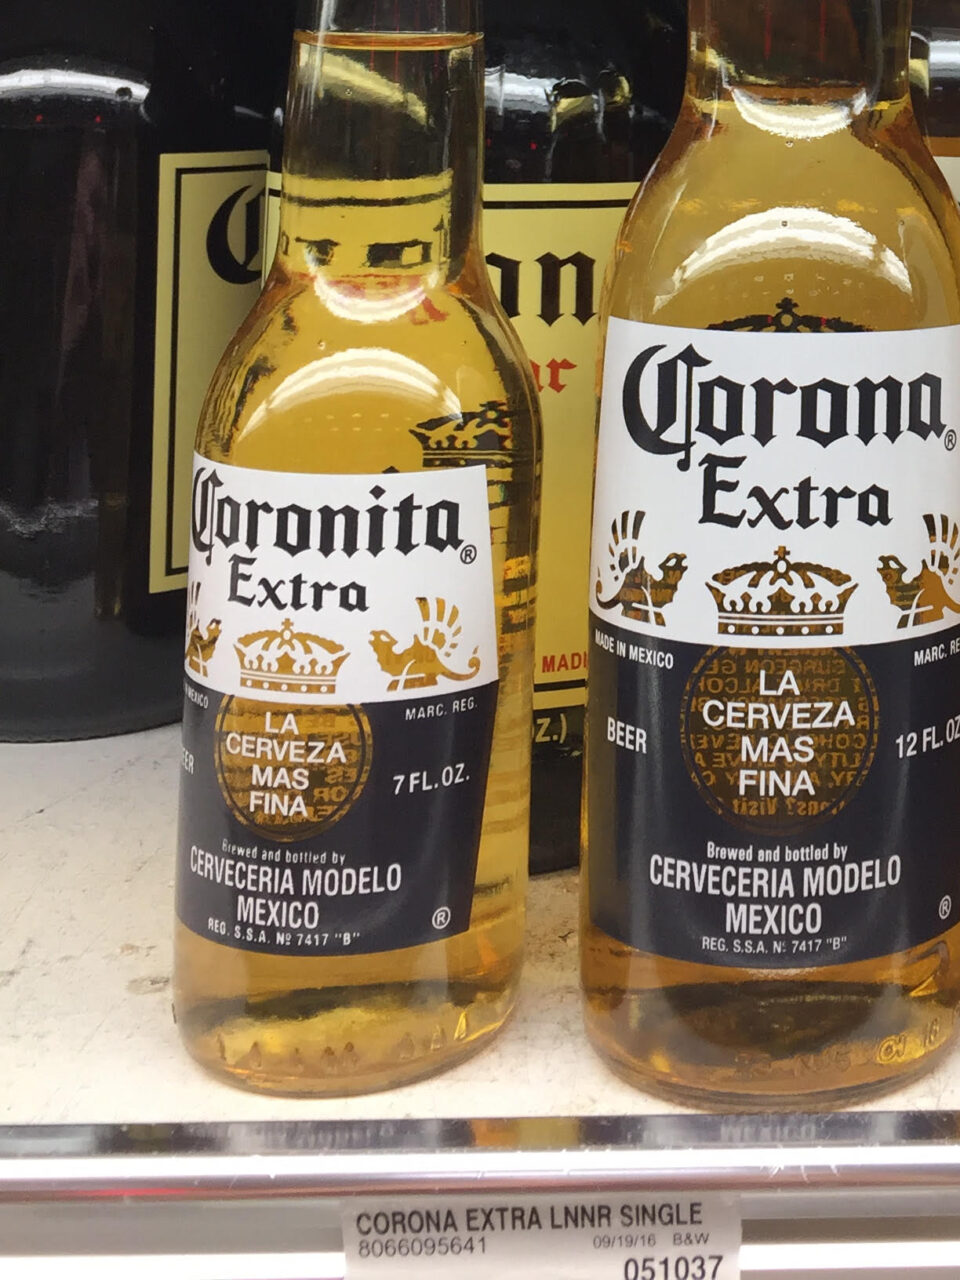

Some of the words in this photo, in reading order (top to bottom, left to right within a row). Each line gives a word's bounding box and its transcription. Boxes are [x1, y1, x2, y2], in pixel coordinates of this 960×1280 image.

[621, 342, 947, 472] Corona
[697, 453, 894, 530] Extra
[193, 466, 464, 566] Coronita
[227, 553, 369, 613] Extra
[595, 628, 614, 654] MADE
[616, 639, 627, 659] IN
[629, 643, 674, 670] MEXICO
[913, 643, 948, 667] MARC.
[759, 669, 800, 696] LA
[405, 703, 447, 721] MARC.
[452, 696, 478, 713] REG.
[702, 699, 856, 730] CERVEZA
[265, 711, 299, 735] LA
[607, 716, 647, 754] BEER
[225, 733, 347, 764] CERVEZA
[741, 735, 815, 763] MAS
[251, 764, 310, 790] MAS
[738, 769, 816, 797] FINA
[249, 792, 308, 817] FINA
[222, 838, 258, 859] Brewed
[261, 849, 280, 862] and
[331, 851, 346, 866] by
[707, 841, 753, 861] Brewed
[757, 845, 780, 862] and
[785, 844, 829, 862] bottled
[833, 842, 848, 861] by
[190, 845, 295, 896] CERVECERIA
[302, 863, 402, 897] MODELO
[650, 854, 795, 899] CERVECERIA
[803, 854, 901, 898] MODELO
[237, 895, 320, 929] MEXICO
[725, 902, 822, 935] MEXICO
[208, 917, 231, 936] REG.
[234, 925, 270, 944] S.S.A.
[296, 932, 329, 946] 7417
[334, 931, 361, 946] "B"
[702, 936, 729, 952] REG.
[733, 939, 768, 954] S.S.A.
[791, 938, 822, 954] 7417
[826, 936, 848, 951] "B"
[356, 1210, 459, 1236] CORONA
[465, 1206, 542, 1232] EXTRA
[549, 1204, 611, 1230] LNNR
[620, 1201, 702, 1228] SINGLE
[358, 1236, 488, 1258] 8066095641
[592, 1232, 657, 1250] 09/19/16
[672, 1232, 710, 1247] B&W
[623, 1253, 724, 1280] 051037
